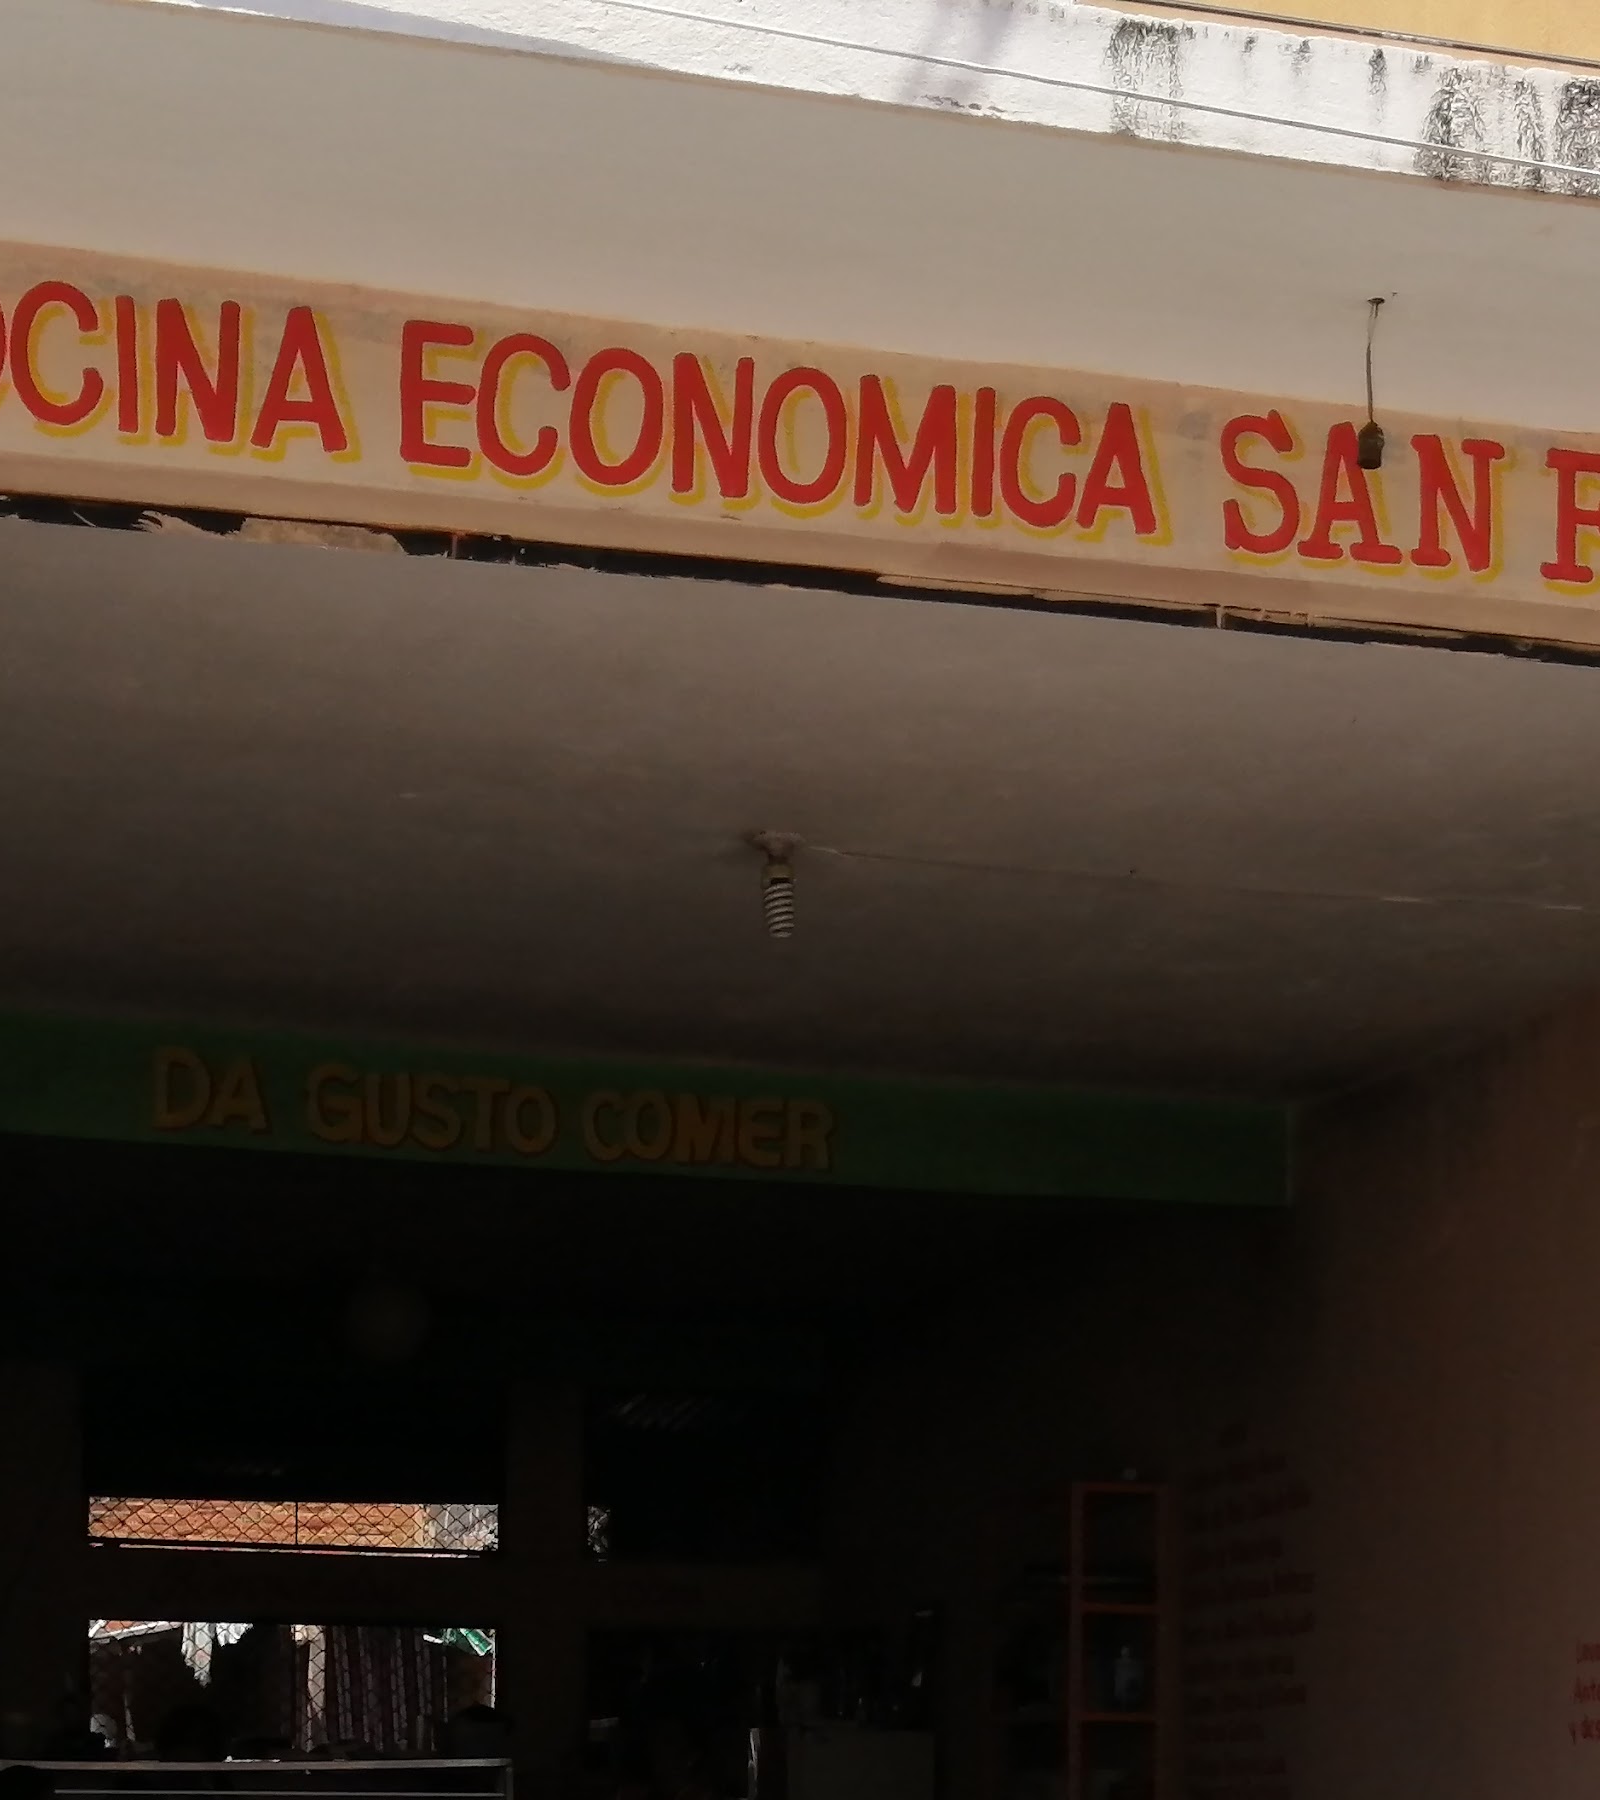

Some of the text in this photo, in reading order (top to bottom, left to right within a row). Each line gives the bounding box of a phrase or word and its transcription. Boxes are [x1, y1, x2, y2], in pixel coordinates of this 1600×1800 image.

[400, 318, 1158, 536] ECONOMICA
[1218, 407, 1506, 574] SAN
[150, 1043, 841, 1172] DA GUSTO COMER
